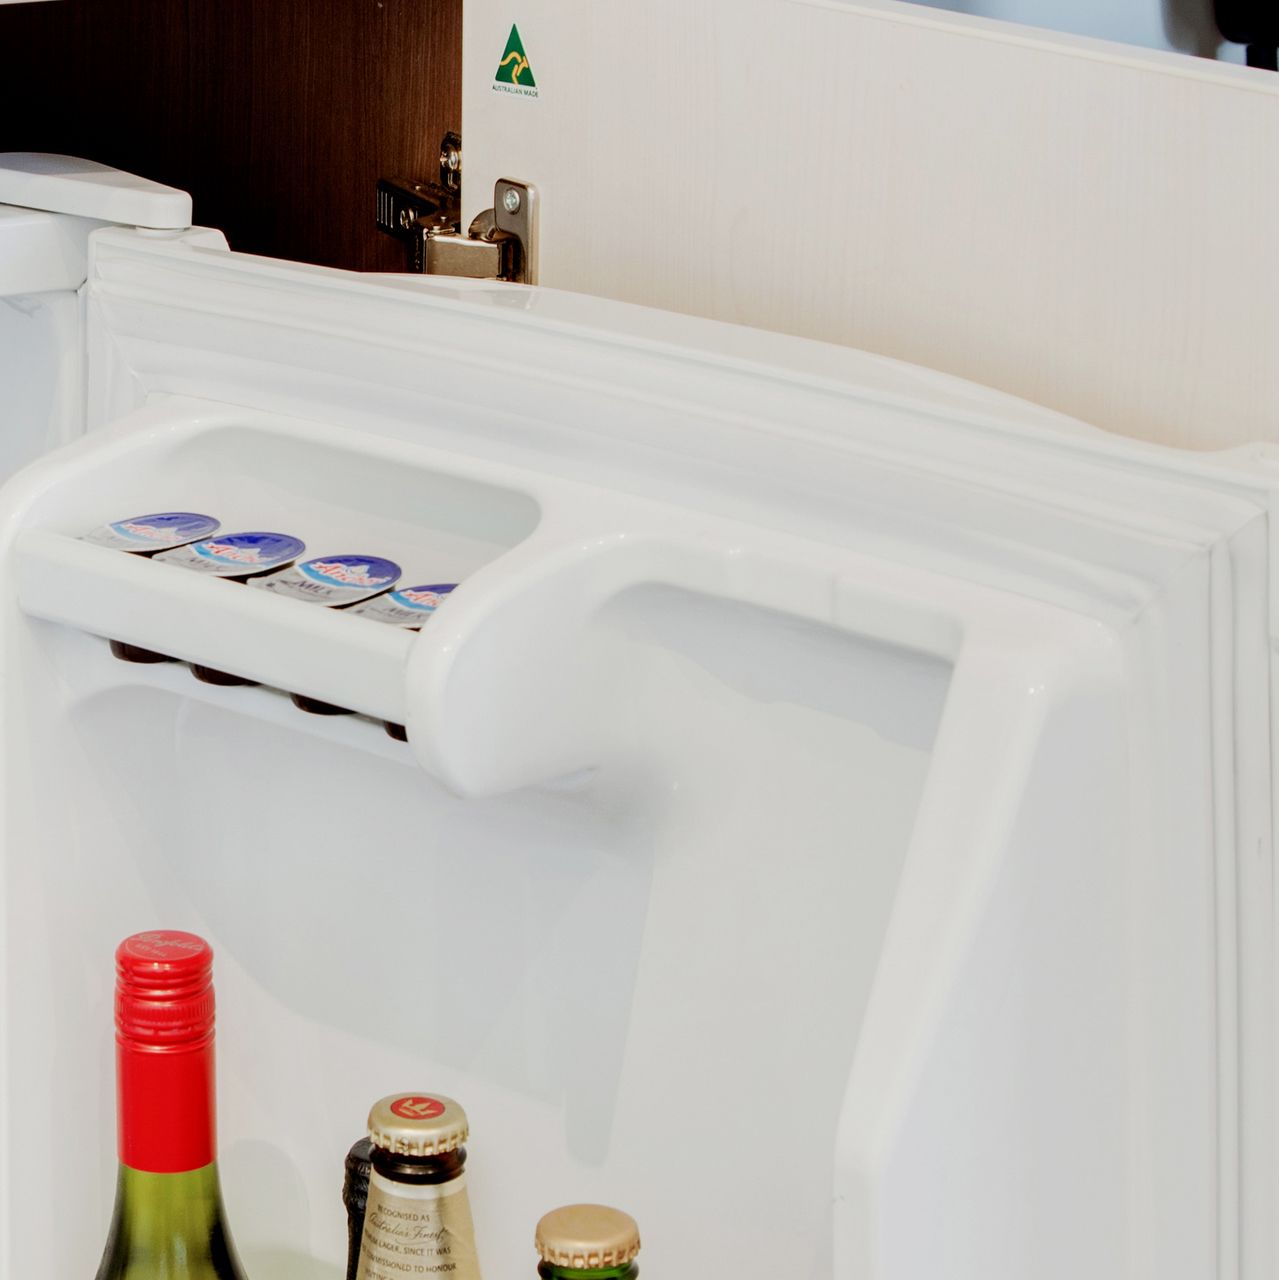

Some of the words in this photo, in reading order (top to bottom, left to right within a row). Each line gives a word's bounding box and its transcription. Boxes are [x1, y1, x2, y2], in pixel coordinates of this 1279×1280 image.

[377, 1204, 418, 1222] RECOGNISED
[403, 1247, 425, 1256] SINCE
[436, 1247, 451, 1256] WAS
[414, 1264, 423, 1272] TO
[426, 1262, 456, 1272] HONOUR
